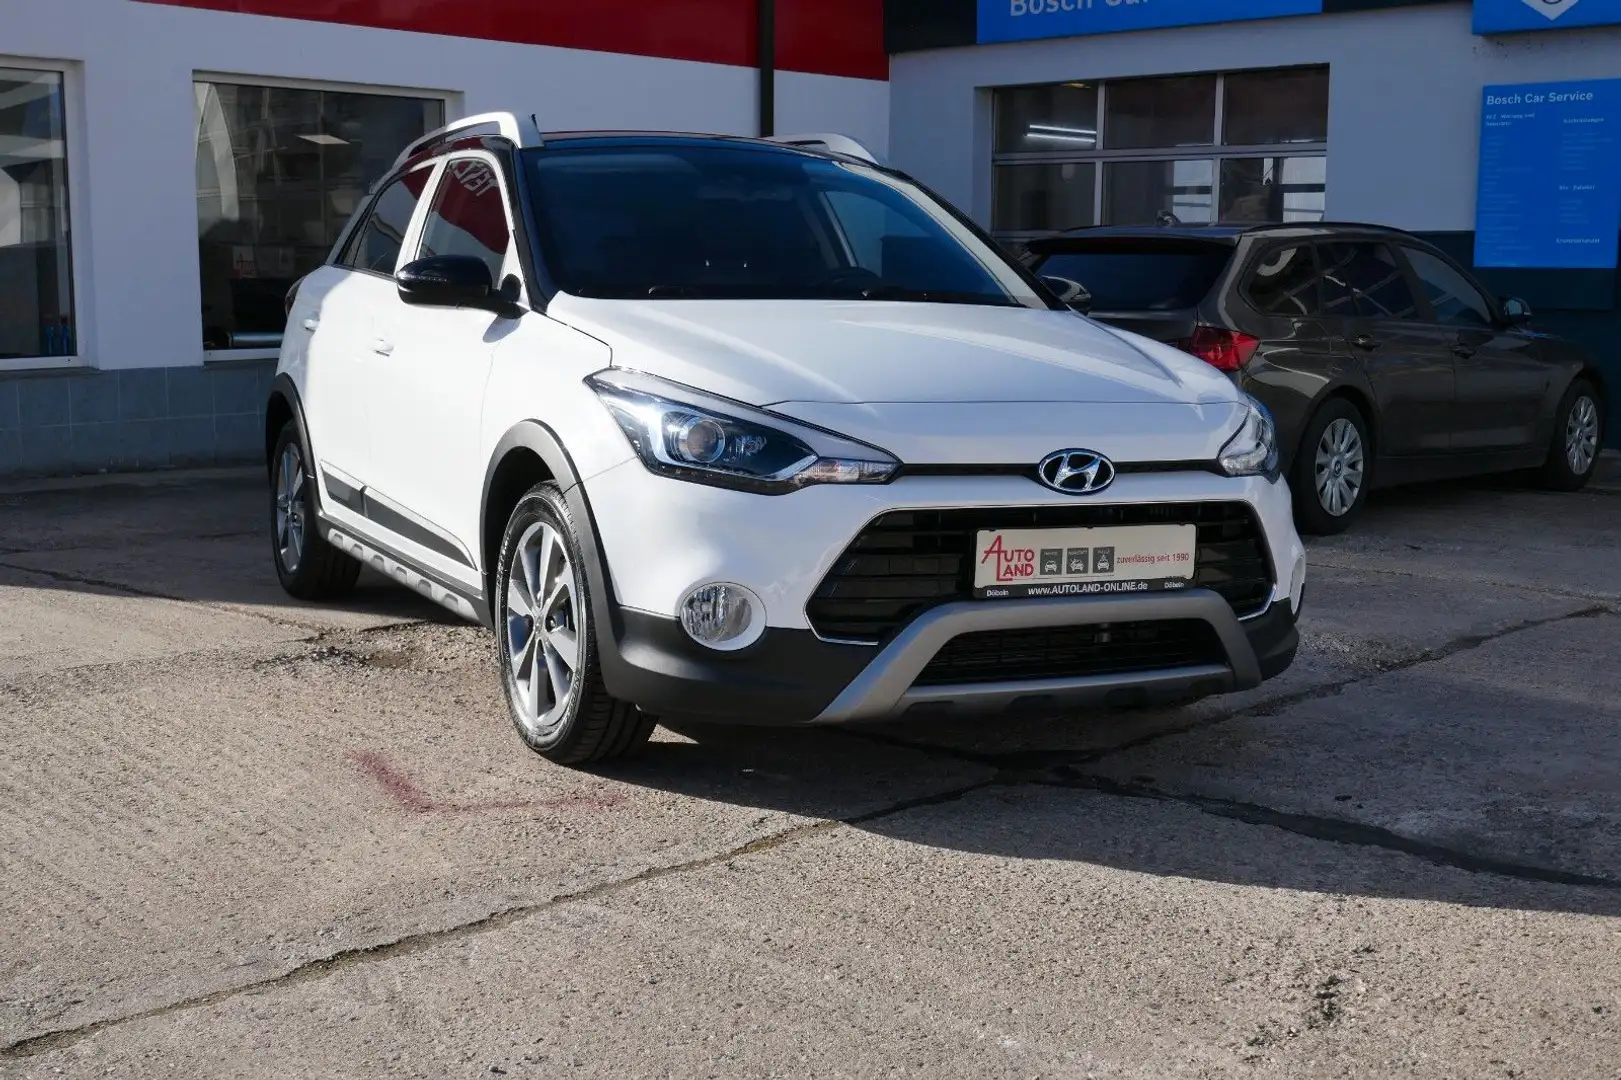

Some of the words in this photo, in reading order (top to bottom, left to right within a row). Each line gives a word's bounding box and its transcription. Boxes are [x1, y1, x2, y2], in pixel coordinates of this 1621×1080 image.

[1486, 93, 1521, 105] Bosch
[1525, 93, 1545, 104] Car
[1548, 90, 1594, 102] Service
[981, 535, 1035, 564] AUTO
[1117, 554, 1155, 564] zuverlässig
[1157, 552, 1170, 562] seit
[1172, 552, 1190, 562] 1990
[1028, 581, 1148, 596] www.AUTOLAND-ONLINE.de
